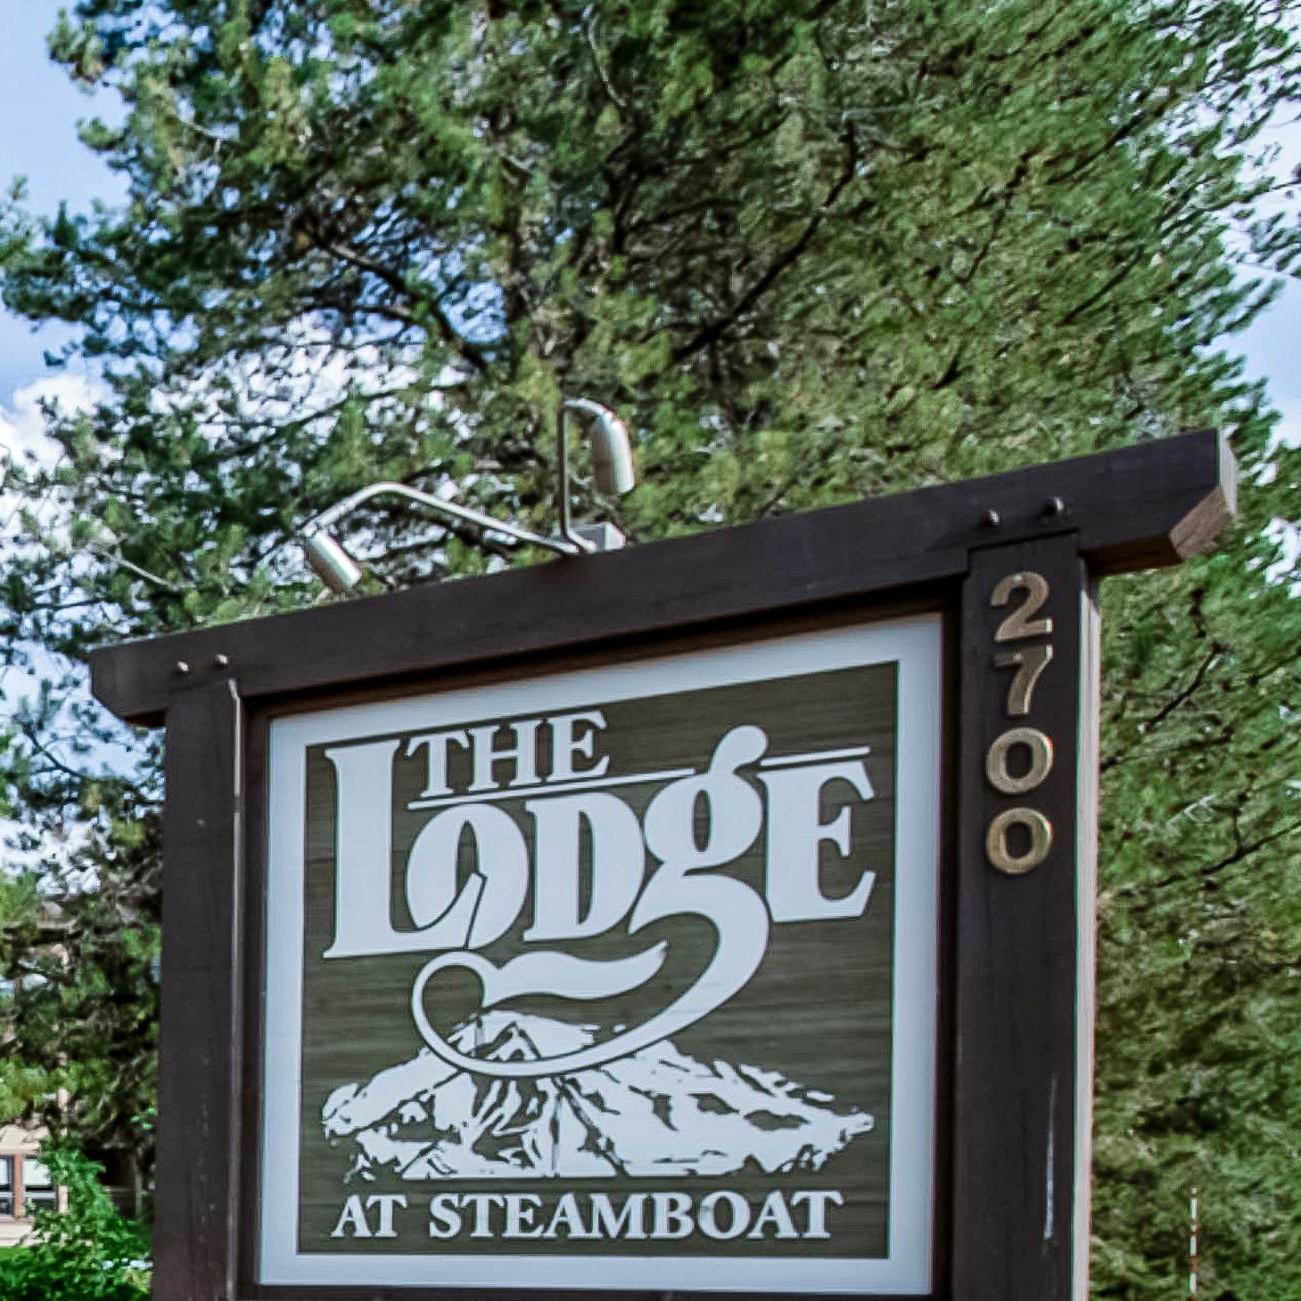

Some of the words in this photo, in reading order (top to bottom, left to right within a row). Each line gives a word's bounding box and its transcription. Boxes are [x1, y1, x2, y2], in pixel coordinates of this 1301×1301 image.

[407, 711, 609, 796] THE
[986, 573, 1054, 875] 2700
[330, 1194, 408, 1238] AT
[429, 1190, 842, 1240] STEAMBOAT
